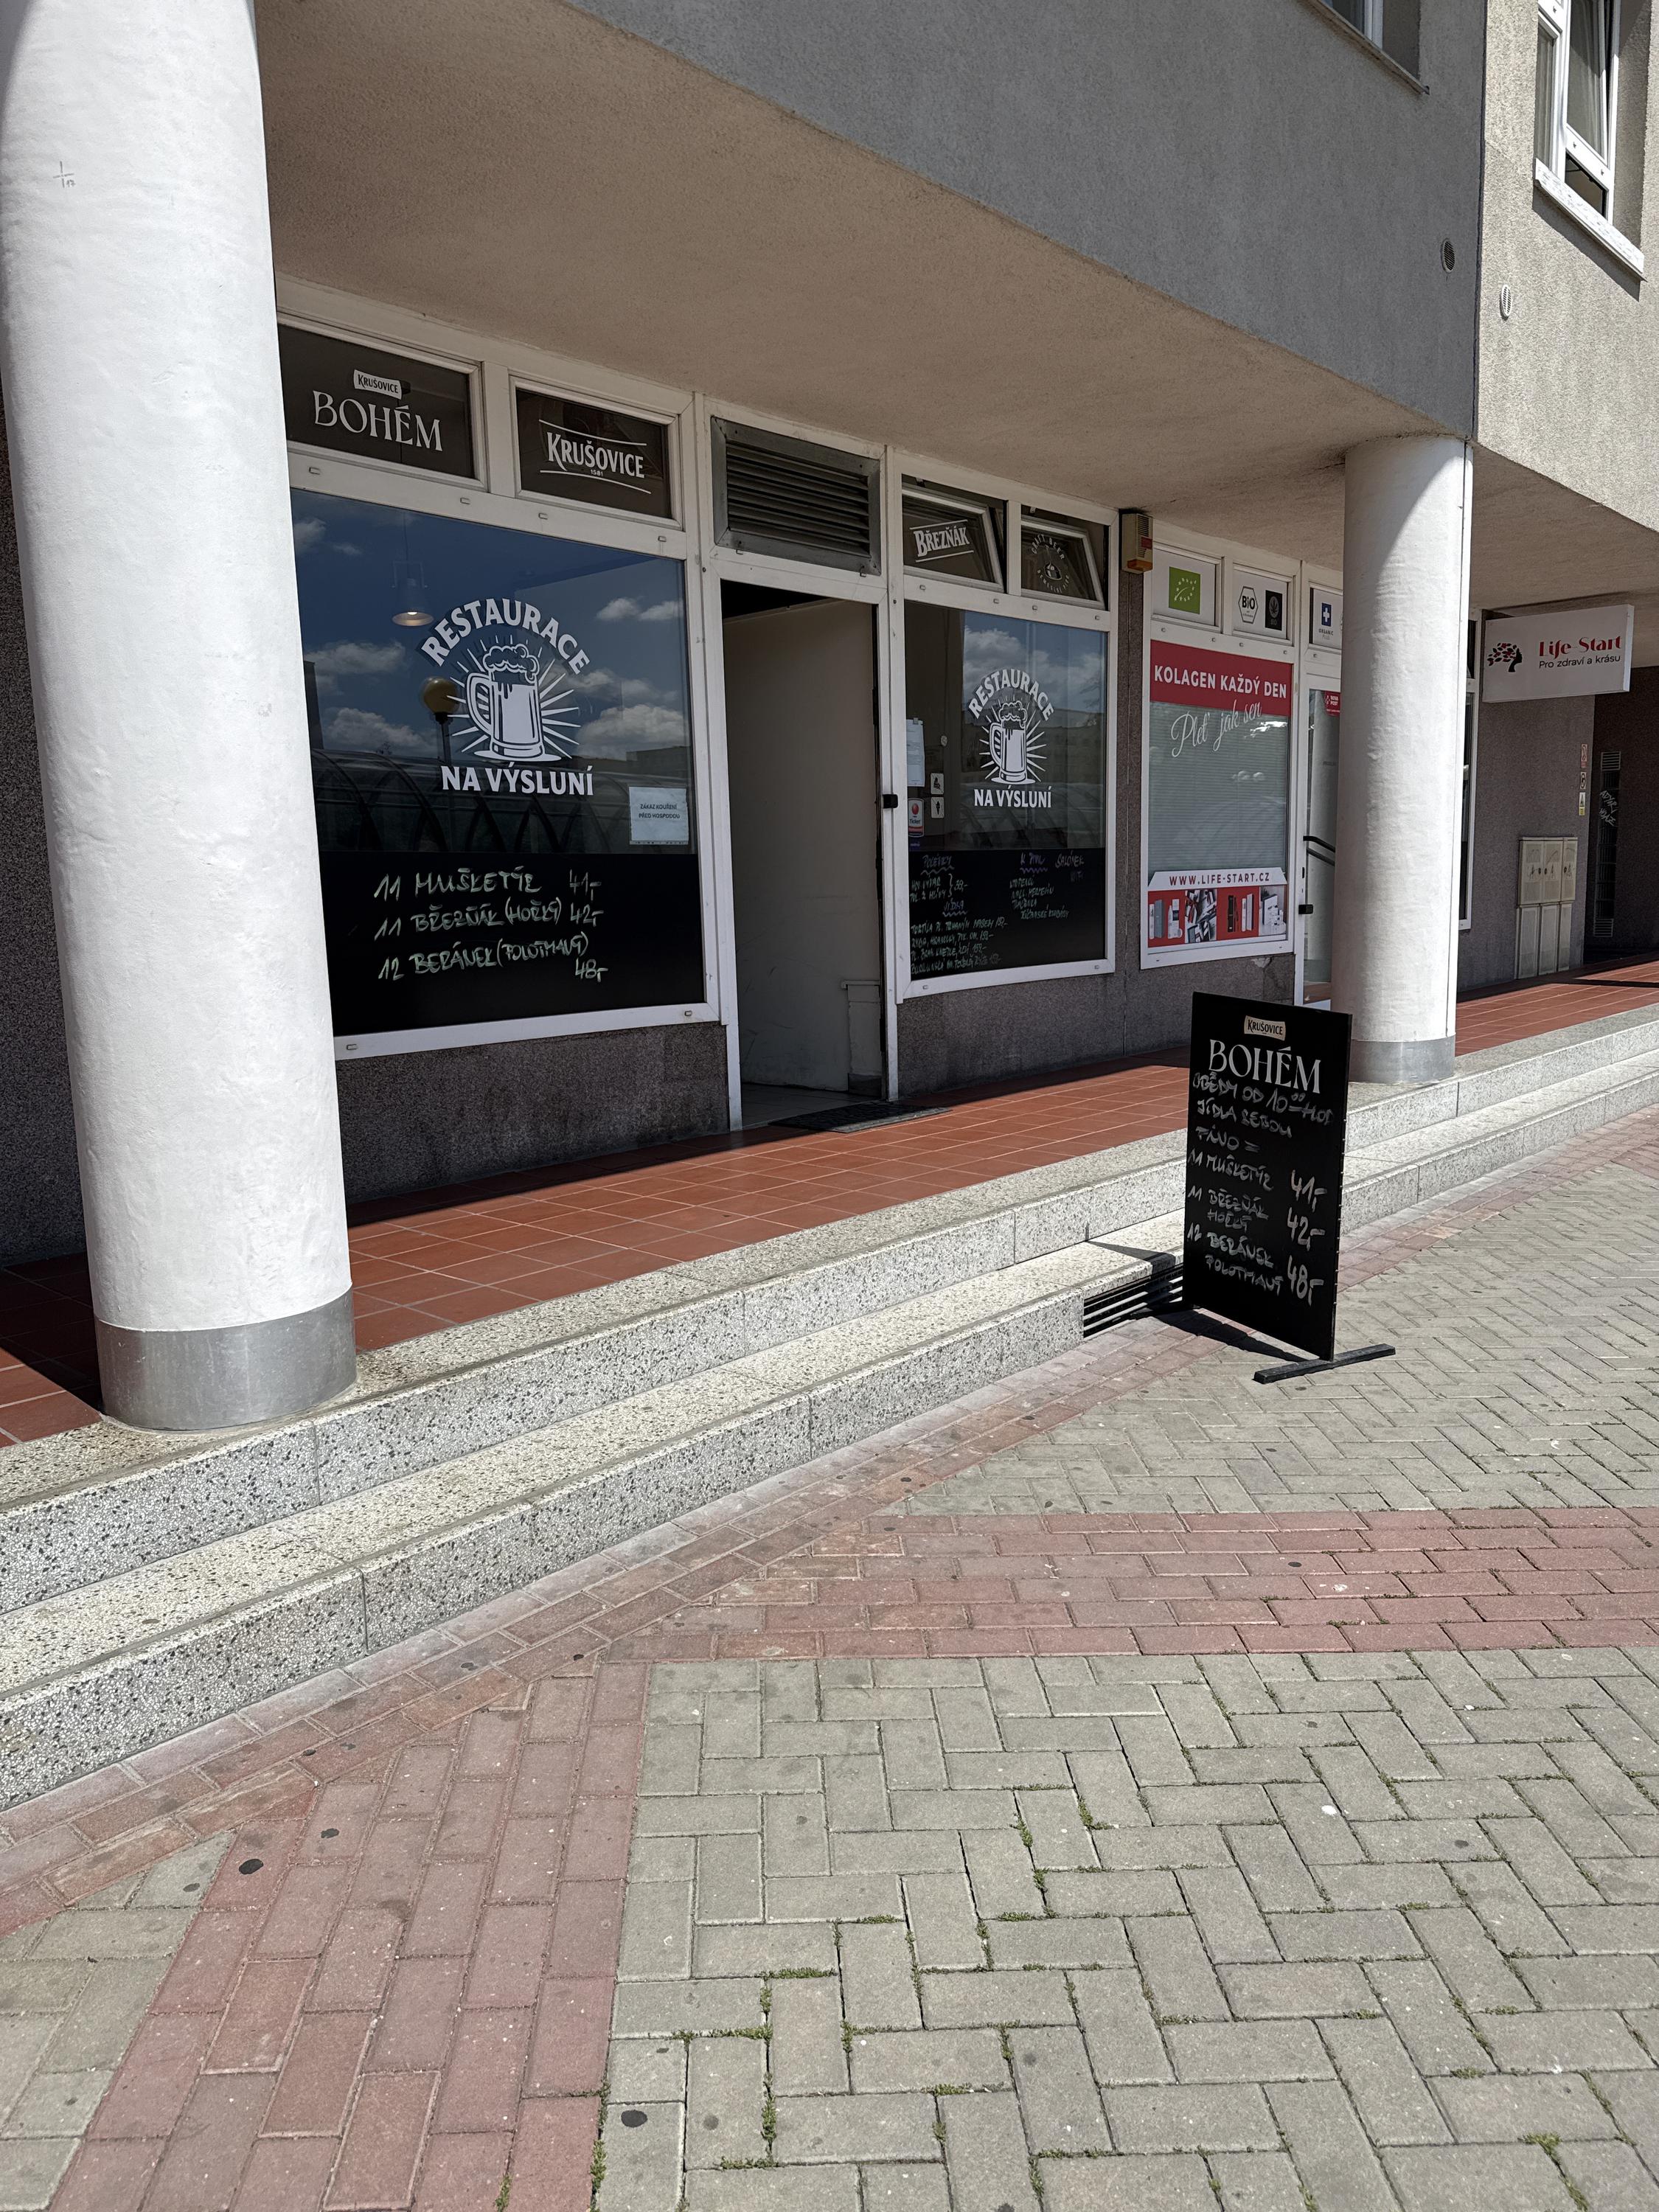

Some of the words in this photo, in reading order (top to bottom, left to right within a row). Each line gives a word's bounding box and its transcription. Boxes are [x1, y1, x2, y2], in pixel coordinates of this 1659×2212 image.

[358, 374, 398, 394] KRUŠOVICE
[313, 390, 443, 453] BOHÉM
[546, 431, 645, 479] KRUŠOVICE
[914, 526, 970, 557] BŘEZŇÁK
[1048, 538, 1065, 560] BEER
[421, 598, 590, 675] RESTAURACE
[1539, 660, 1554, 669] Pro
[1557, 656, 1584, 667] zdraví
[1596, 655, 1621, 664] krásu
[1154, 665, 1216, 689] KOLAGEN
[1220, 674, 1260, 695] KAŽDÝ
[1264, 682, 1287, 698] DEN
[968, 669, 1054, 722] RESTAURACE
[1213, 700, 1240, 751] jak
[1243, 702, 1262, 724] sen
[441, 765, 481, 792] NA
[487, 762, 594, 796] VÝSLUNÍ
[974, 788, 994, 807] NA
[996, 785, 1051, 808] VÝSLUNÍ
[374, 874, 401, 901] 11
[1169, 872, 1270, 886] WWW.LIFE-START.CZ
[374, 917, 401, 941] 11
[378, 956, 405, 981] 12
[408, 941, 498, 974] BERÁNEK
[1248, 1019, 1283, 1035] KRUŠOVICE
[1208, 1039, 1321, 1094] BOHÉM
[1242, 1087, 1265, 1103] OD
[1197, 1096, 1237, 1122] JÍDLA
[1187, 1222, 1203, 1242] 12
